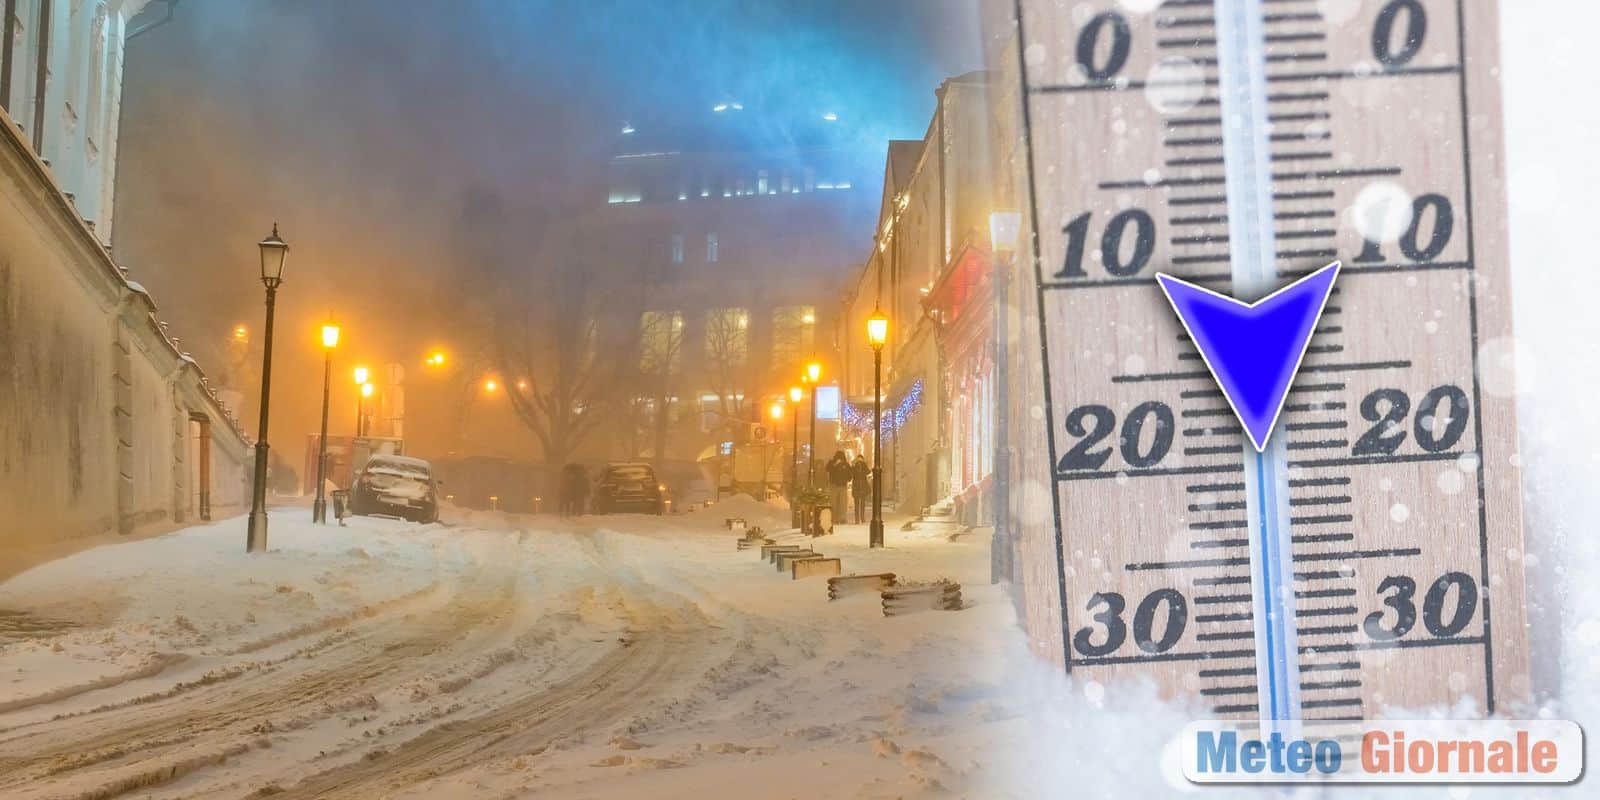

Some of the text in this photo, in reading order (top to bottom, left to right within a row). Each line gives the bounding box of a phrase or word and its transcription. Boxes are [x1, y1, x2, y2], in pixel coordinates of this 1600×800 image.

[1076, 11, 1132, 82] 0
[1372, 0, 1427, 65] 0
[1054, 208, 1156, 279] 10
[1057, 400, 1176, 472] 20
[1352, 384, 1469, 457] 20
[1072, 587, 1188, 658] 30
[1363, 571, 1478, 640] 30
